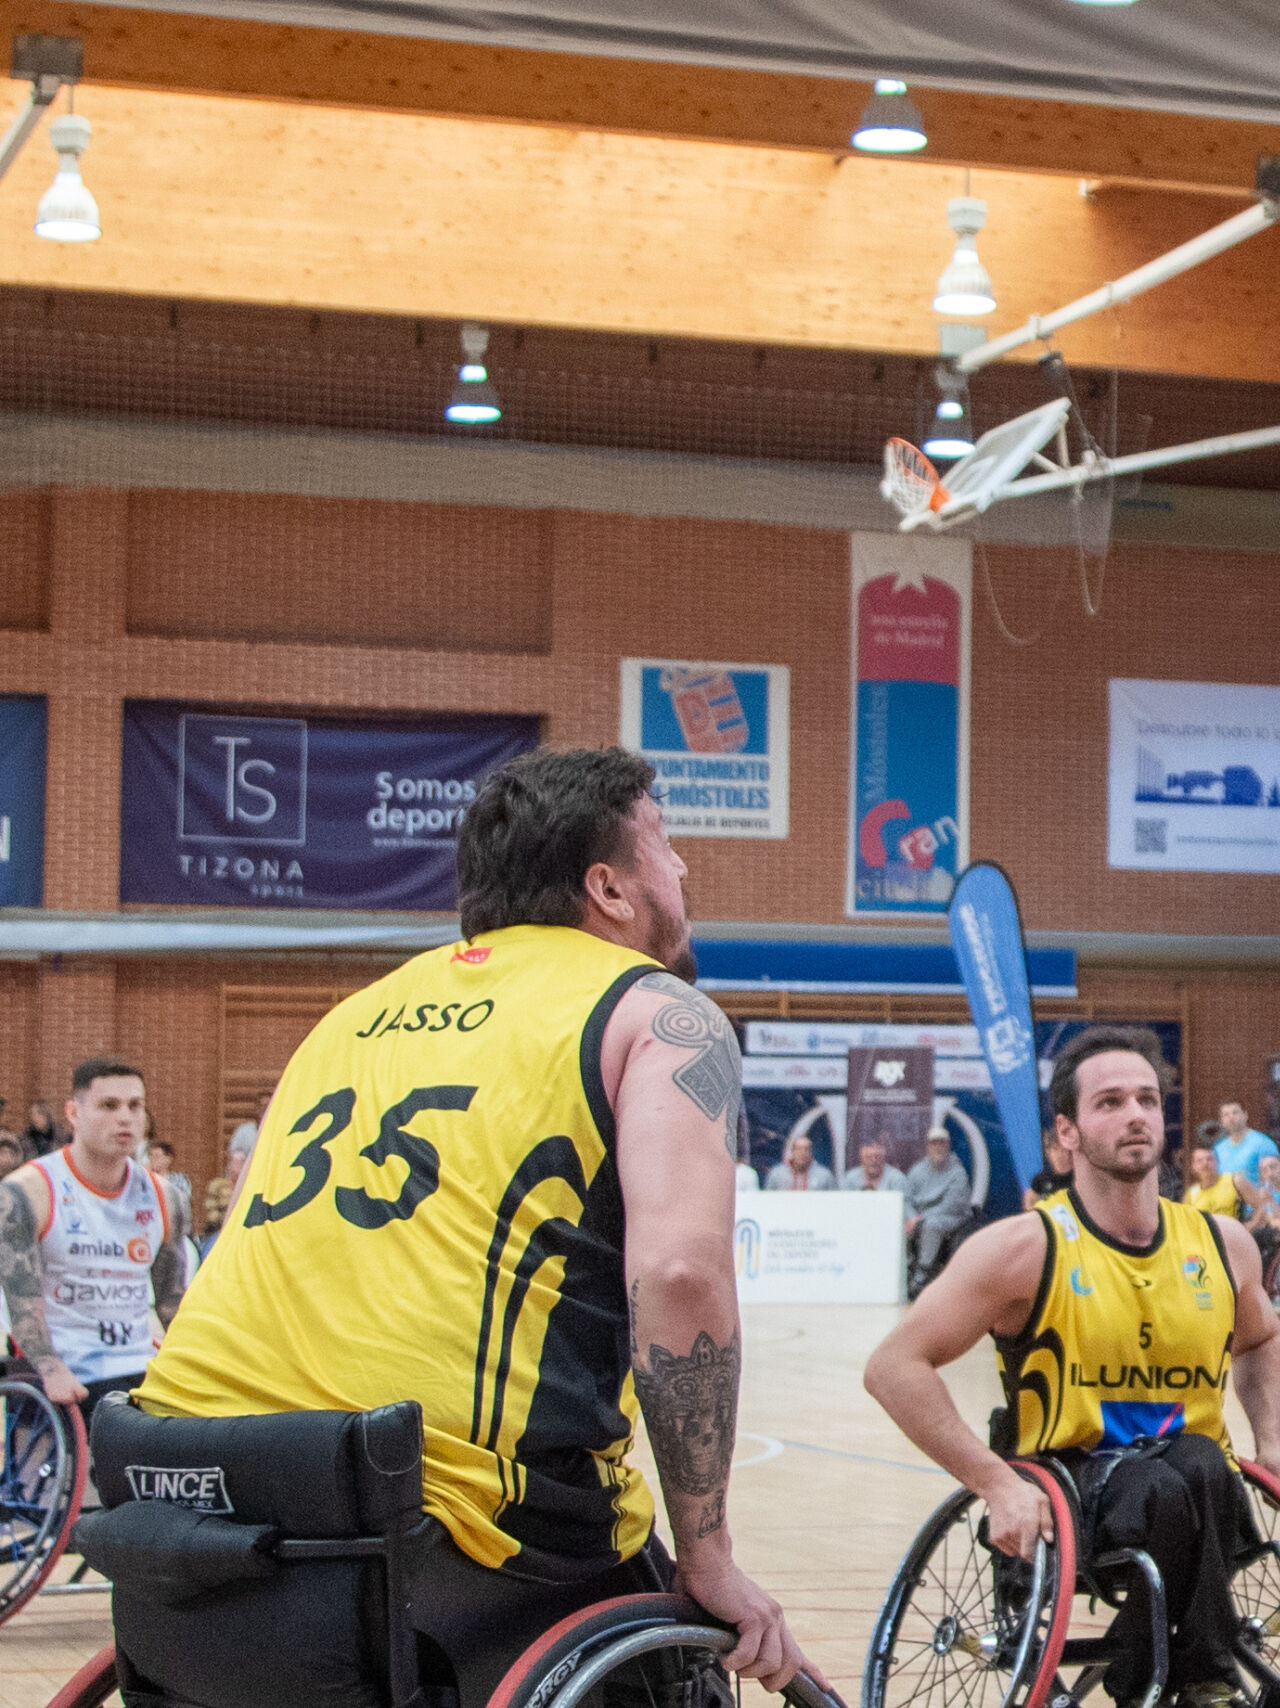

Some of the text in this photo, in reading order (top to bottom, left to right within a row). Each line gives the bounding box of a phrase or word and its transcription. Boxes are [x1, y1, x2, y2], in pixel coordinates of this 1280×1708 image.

[376, 771, 477, 801] Somos
[179, 855, 304, 881] TIZONA
[356, 999, 494, 1038] JASSO
[243, 1085, 479, 1230] 35
[1138, 1322, 1153, 1350] 5
[1070, 1362, 1222, 1391] ILUNION
[140, 1472, 219, 1499] LINCE
